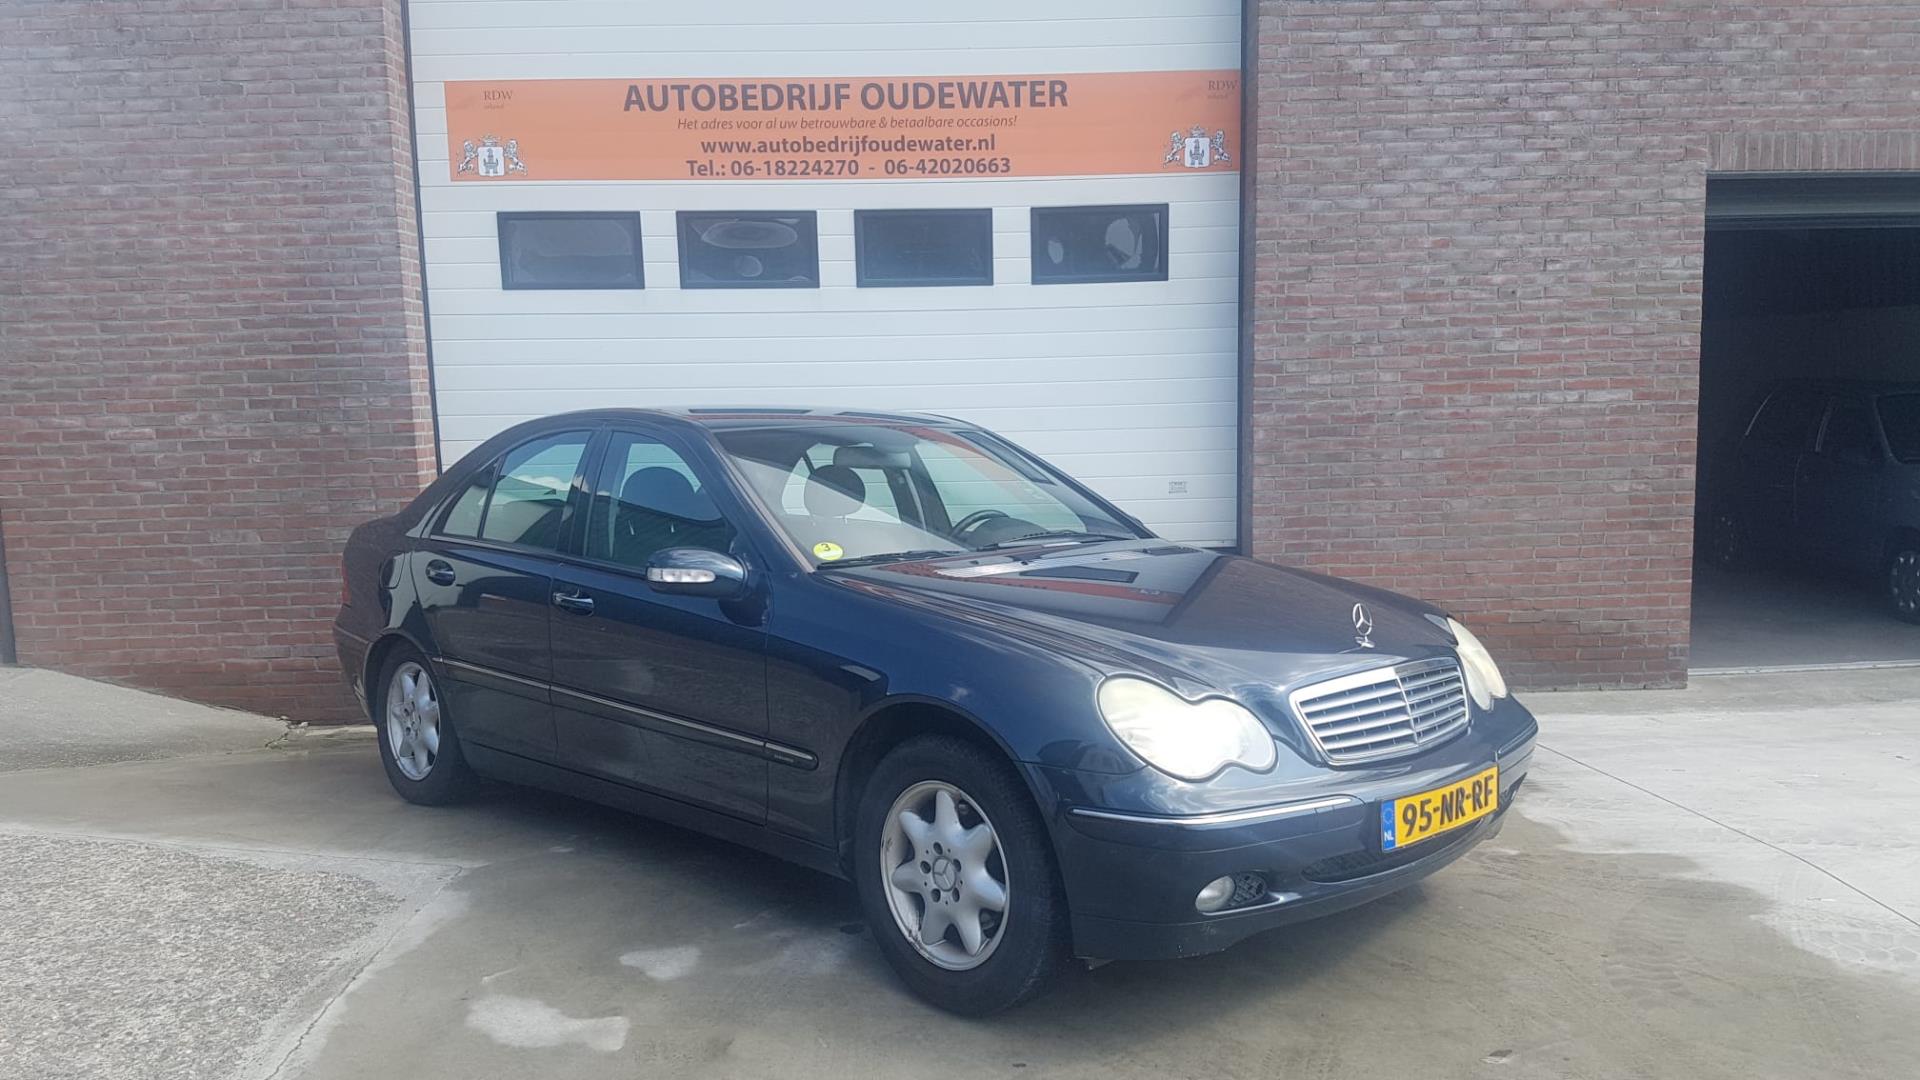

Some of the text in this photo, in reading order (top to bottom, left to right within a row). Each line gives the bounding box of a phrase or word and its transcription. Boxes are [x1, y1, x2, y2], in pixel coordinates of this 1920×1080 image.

[484, 90, 513, 101] RDW
[624, 80, 1068, 112] AUTOBEDRIJF OUDEWATER
[677, 115, 1018, 130] Het adres voor al uw betrouwbare & betaalbare occasions!
[700, 134, 996, 157] www.autobedrijfoudewater.nl
[686, 160, 726, 177] Tel.:
[731, 159, 859, 176] 06-18224270
[884, 157, 1011, 175] 06-42020663
[821, 543, 831, 552] 3
[1402, 774, 1494, 838] 95-NR-RF
[1384, 830, 1394, 841] NL
